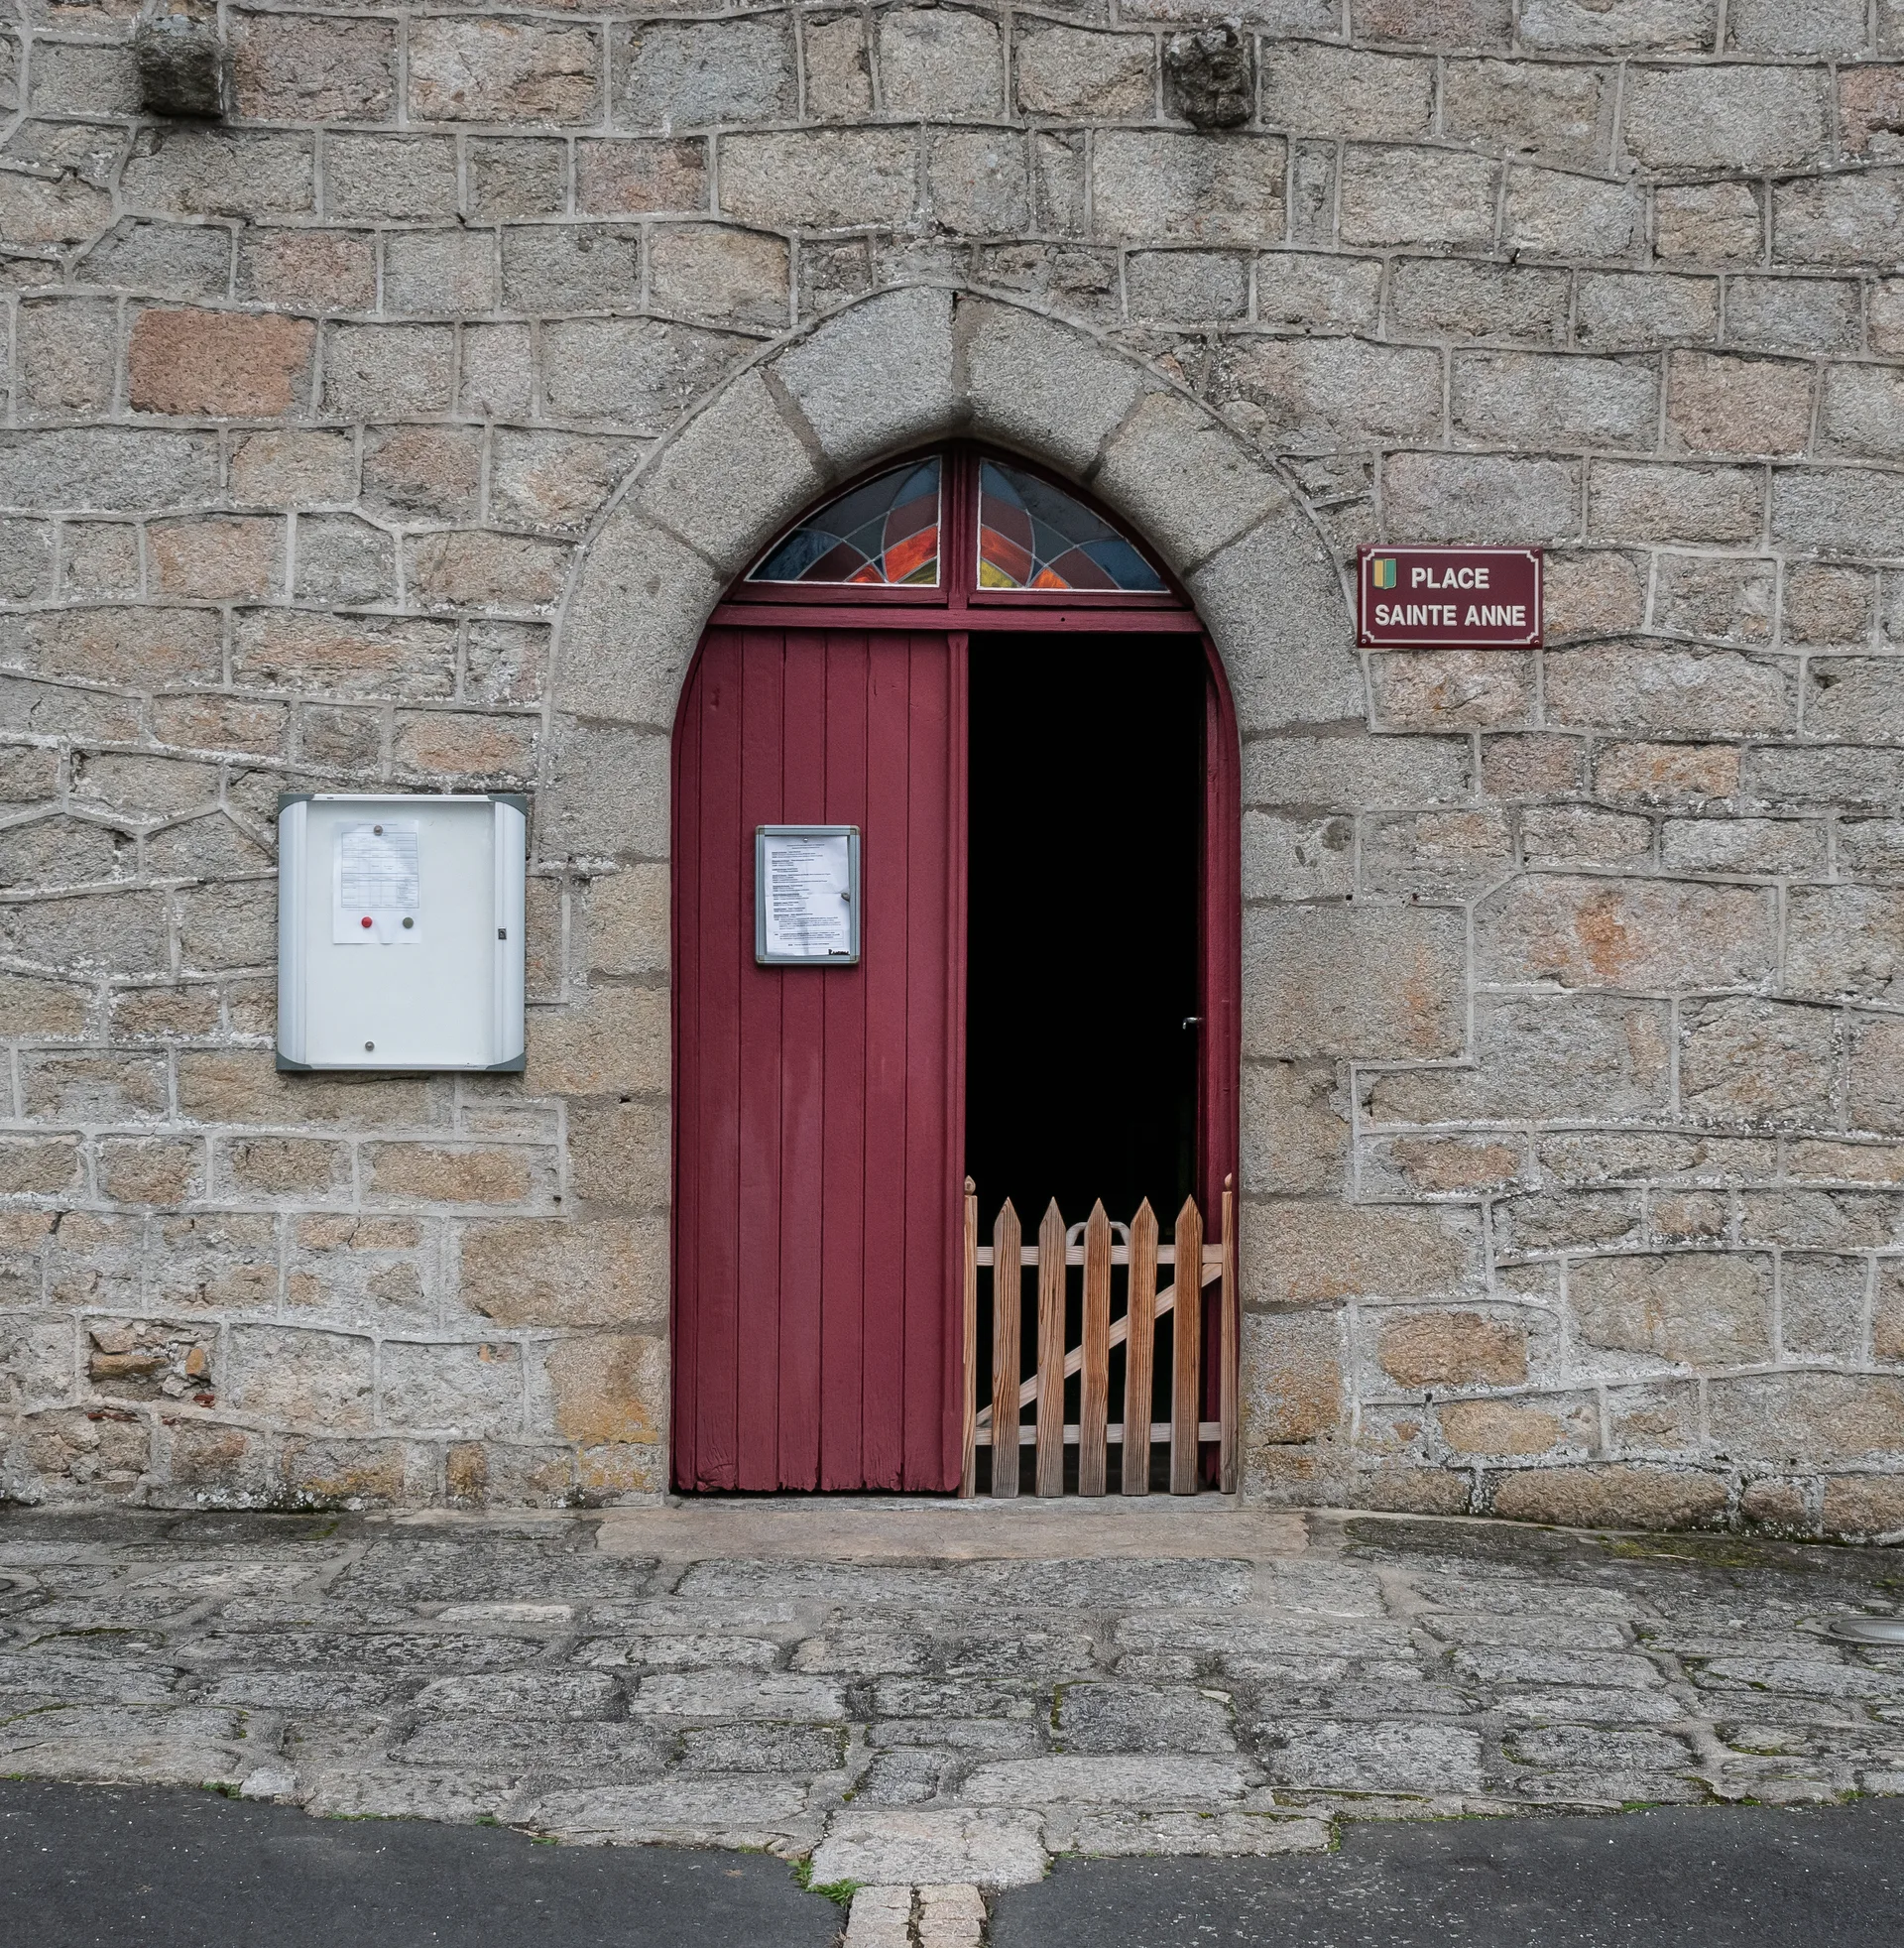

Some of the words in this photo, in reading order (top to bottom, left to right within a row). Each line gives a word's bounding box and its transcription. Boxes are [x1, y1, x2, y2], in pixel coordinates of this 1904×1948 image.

[1411, 567, 1490, 589] PLACE
[1374, 604, 1458, 626] SAINTE
[1465, 605, 1527, 626] ANNE
